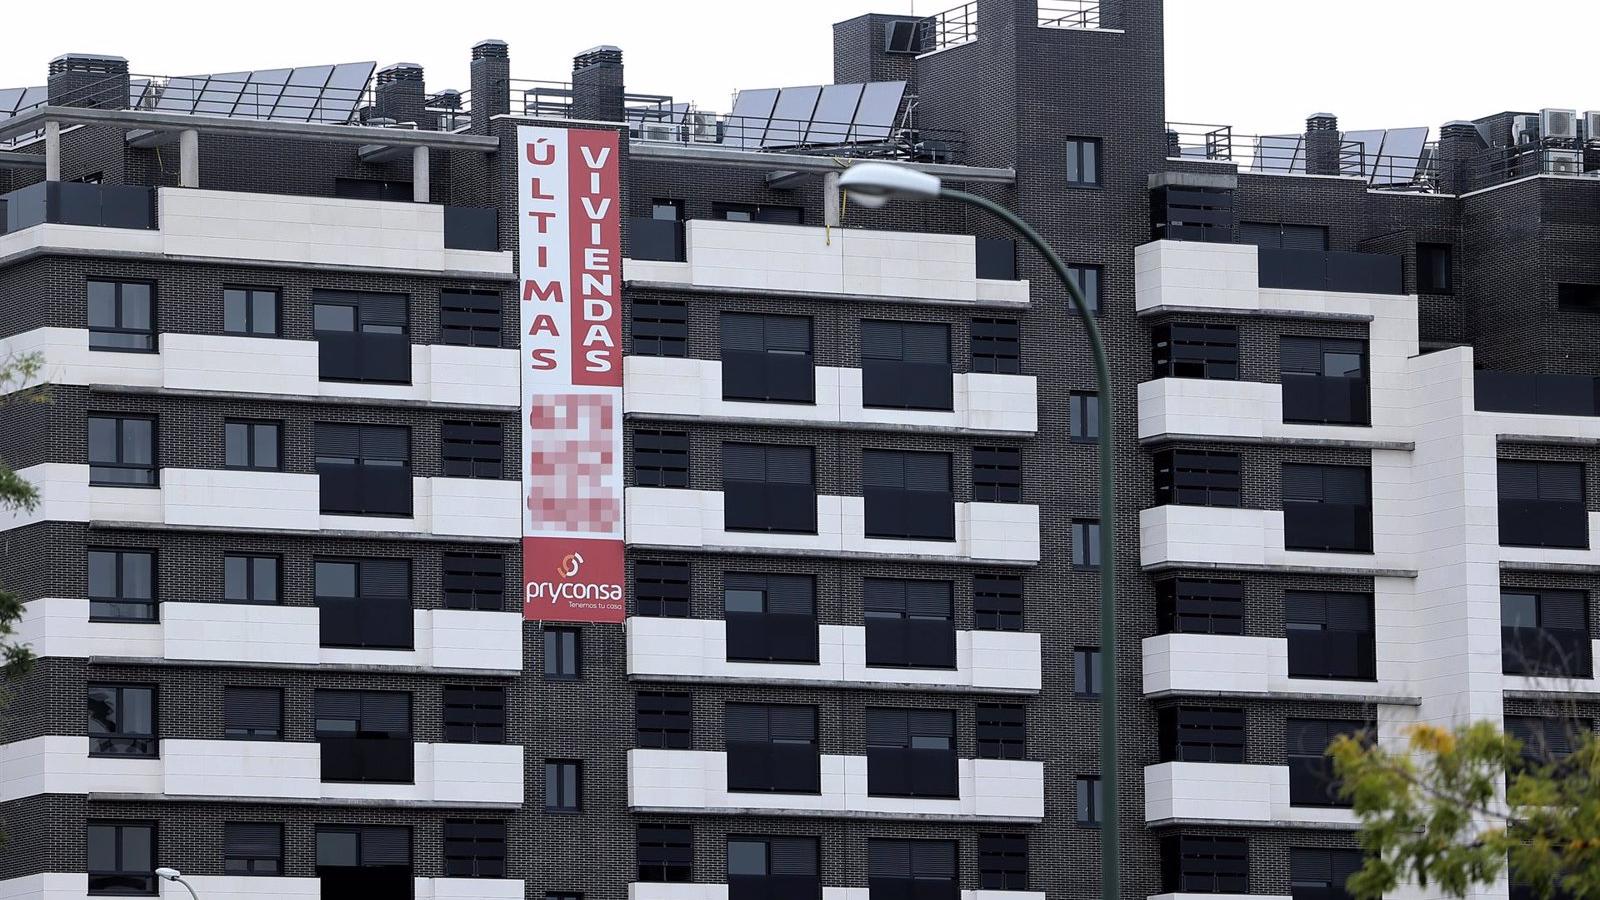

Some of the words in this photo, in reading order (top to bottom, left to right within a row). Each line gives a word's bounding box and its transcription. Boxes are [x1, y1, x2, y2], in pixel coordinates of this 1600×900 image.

[523, 138, 564, 371] ÚLTIMAS
[580, 146, 615, 373] VIVIENDAS
[526, 581, 622, 604] pryconsa
[569, 601, 597, 609] Tenemos
